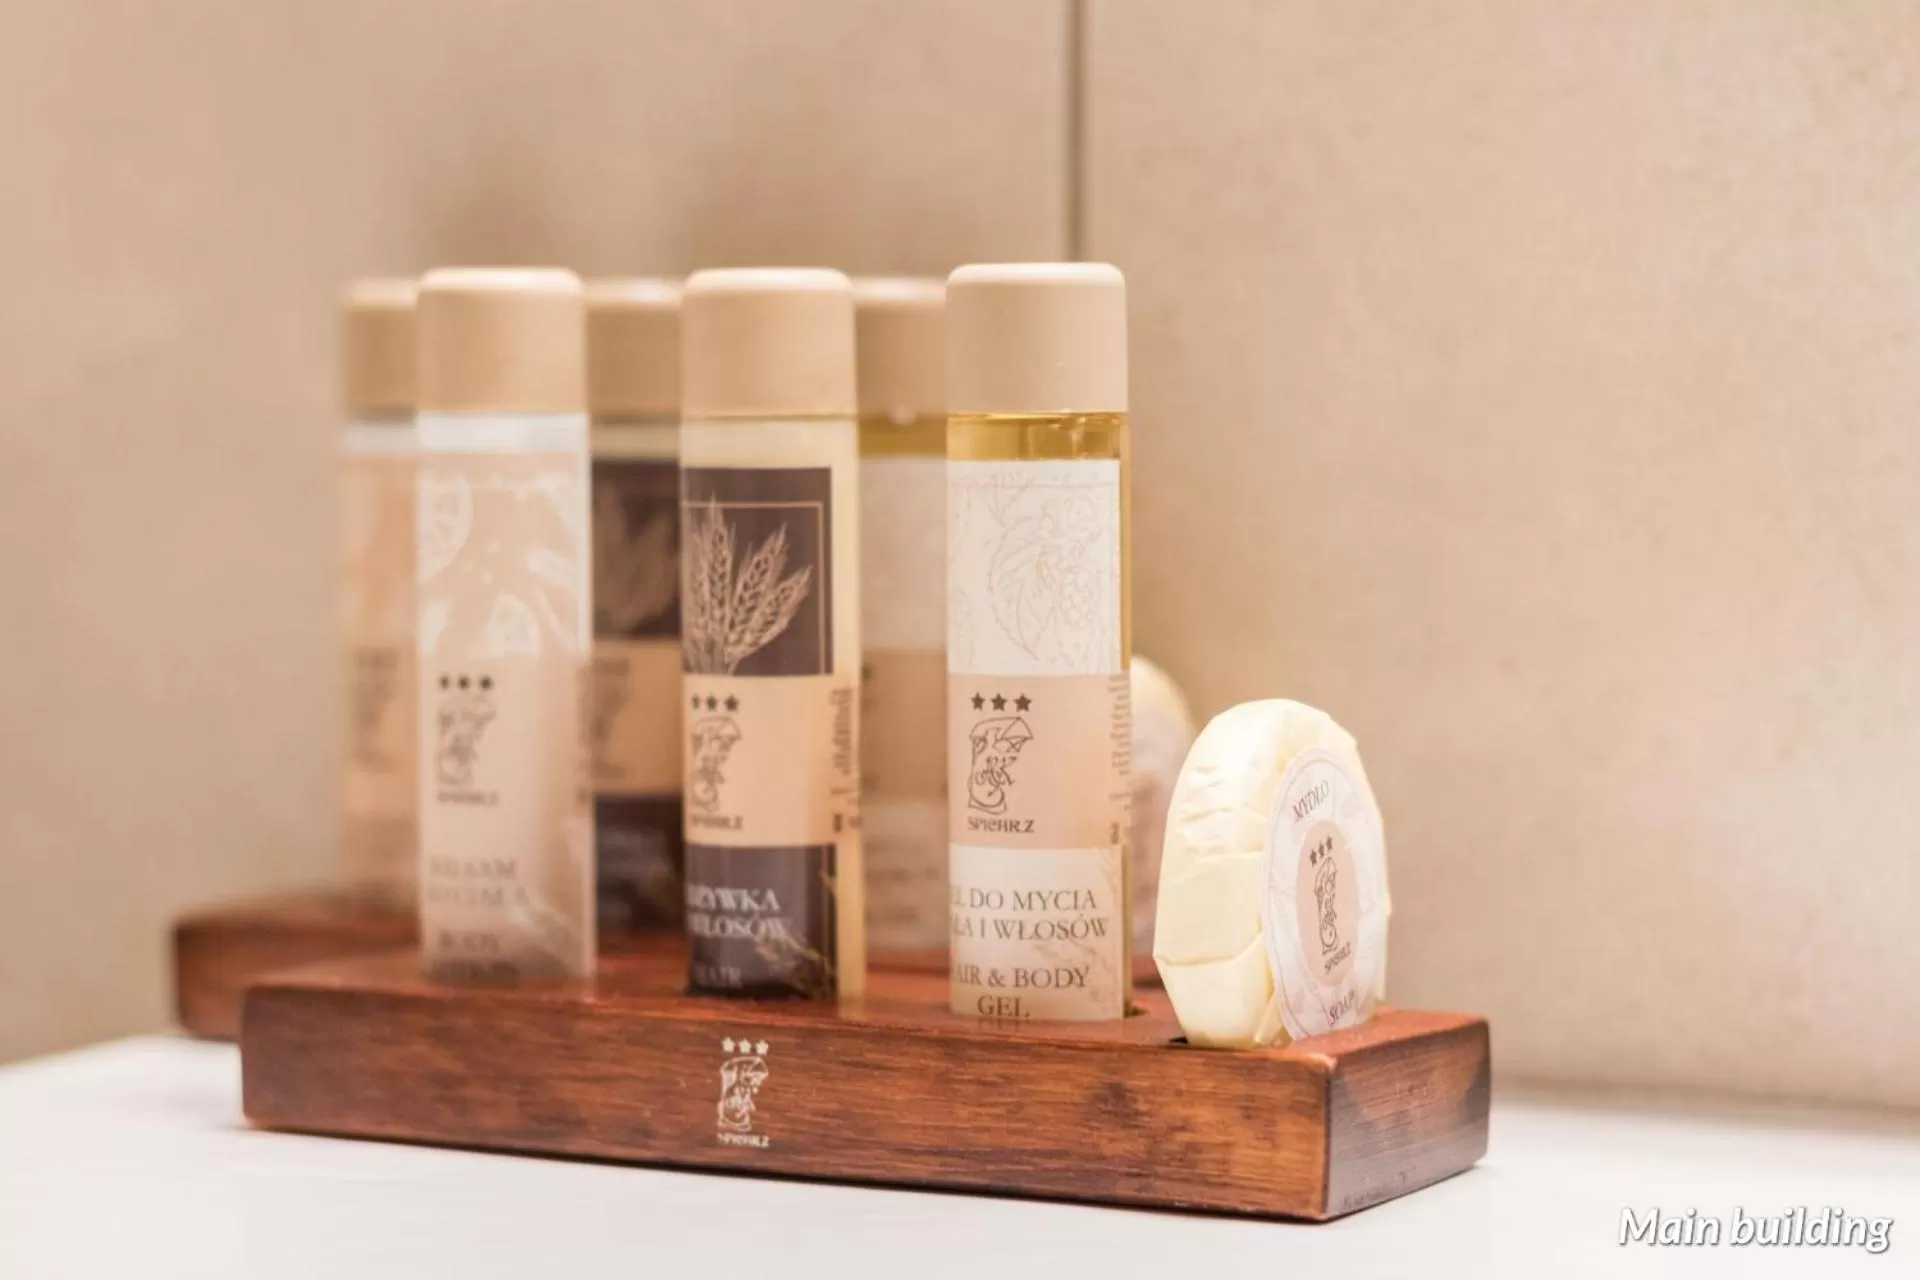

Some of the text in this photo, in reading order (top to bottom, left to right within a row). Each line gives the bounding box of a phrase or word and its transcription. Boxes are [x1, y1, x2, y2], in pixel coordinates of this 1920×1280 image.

[970, 888, 1004, 910] DO
[1012, 889, 1098, 912] MYCIA
[993, 913, 1110, 941] WŁOSÓW
[987, 968, 1006, 988] &
[1013, 964, 1091, 989] BODY
[977, 995, 1030, 1017] GEL
